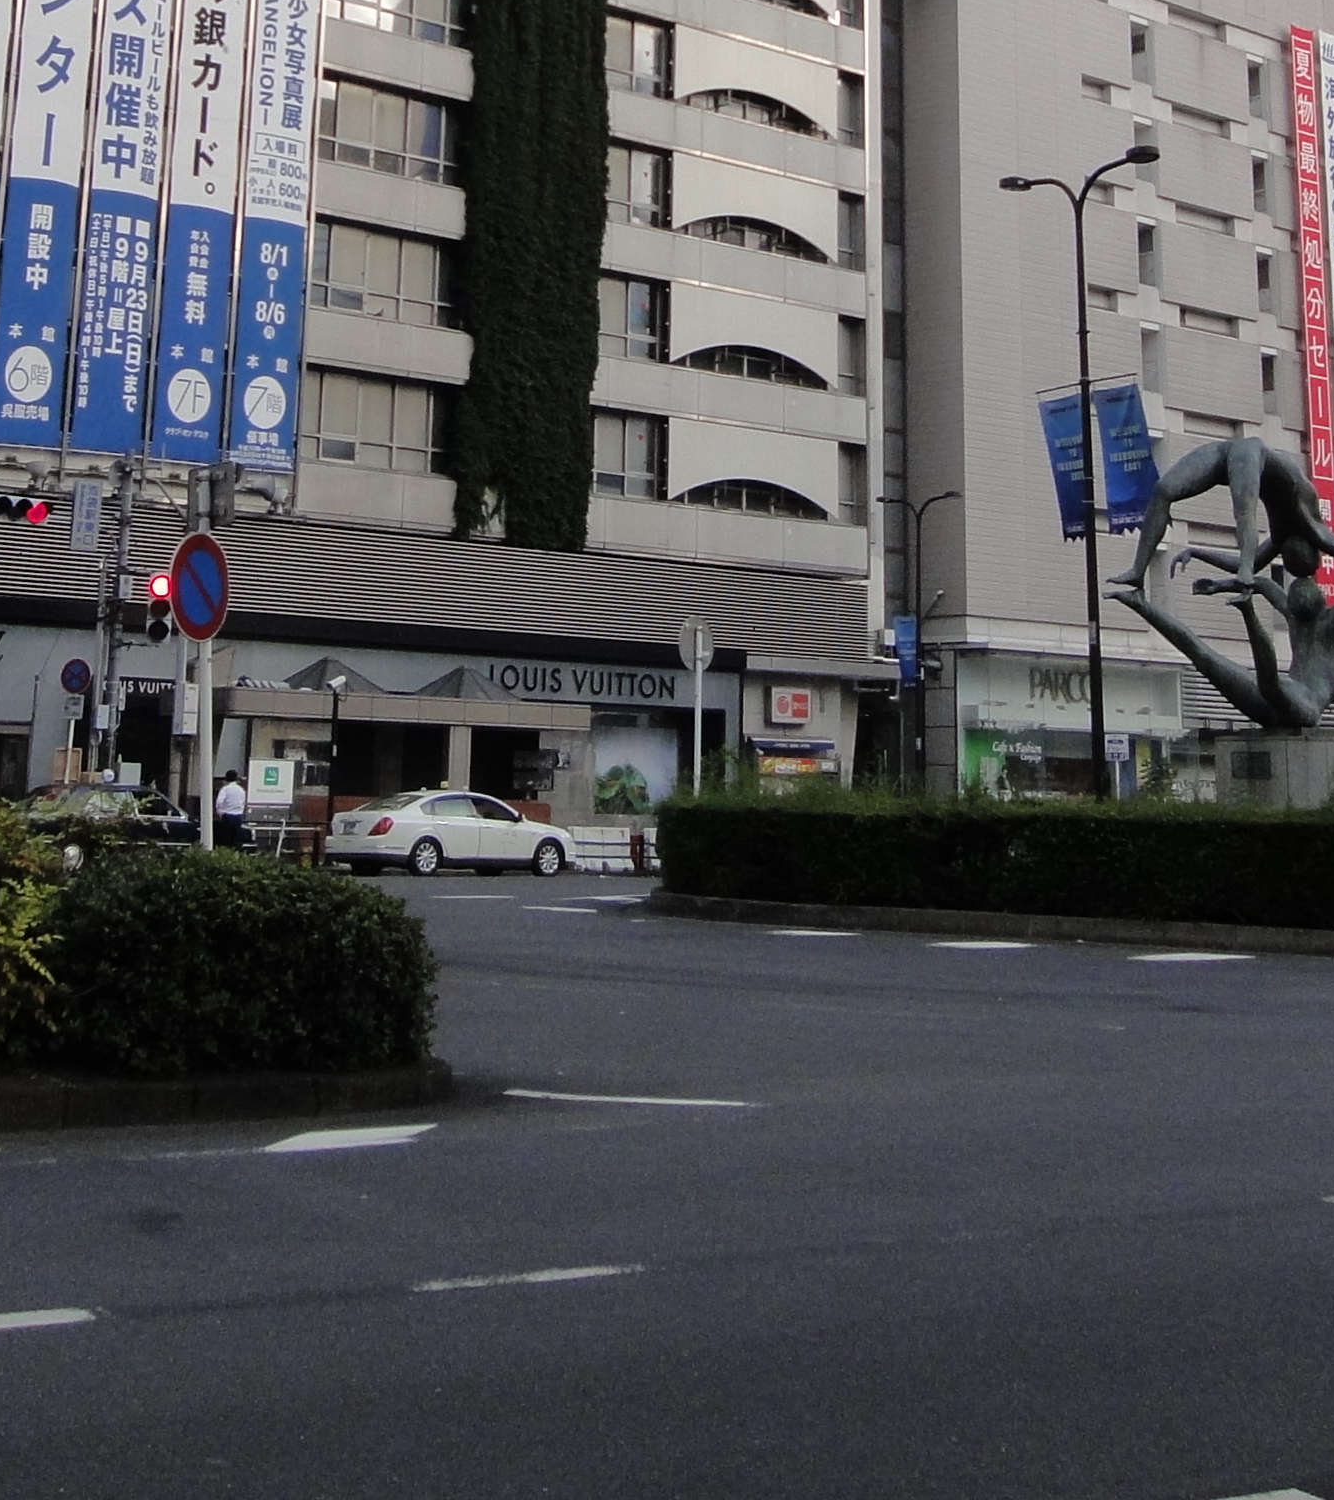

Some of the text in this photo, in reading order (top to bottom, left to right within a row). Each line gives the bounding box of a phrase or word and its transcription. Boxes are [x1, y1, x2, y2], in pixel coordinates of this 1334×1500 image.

[26, 204, 53, 290] 開設中
[260, 243, 288, 267] 8/1
[1295, 47, 1331, 468] 夏物最終処分セール
[184, 271, 208, 326] 無料
[255, 301, 286, 325] 8/6
[8, 323, 55, 343] 本館
[7, 363, 49, 395] 6階
[174, 379, 207, 414] 7F
[248, 385, 283, 419] 7階
[1318, 498, 1334, 575] 開中
[571, 668, 675, 701] VUITTON
